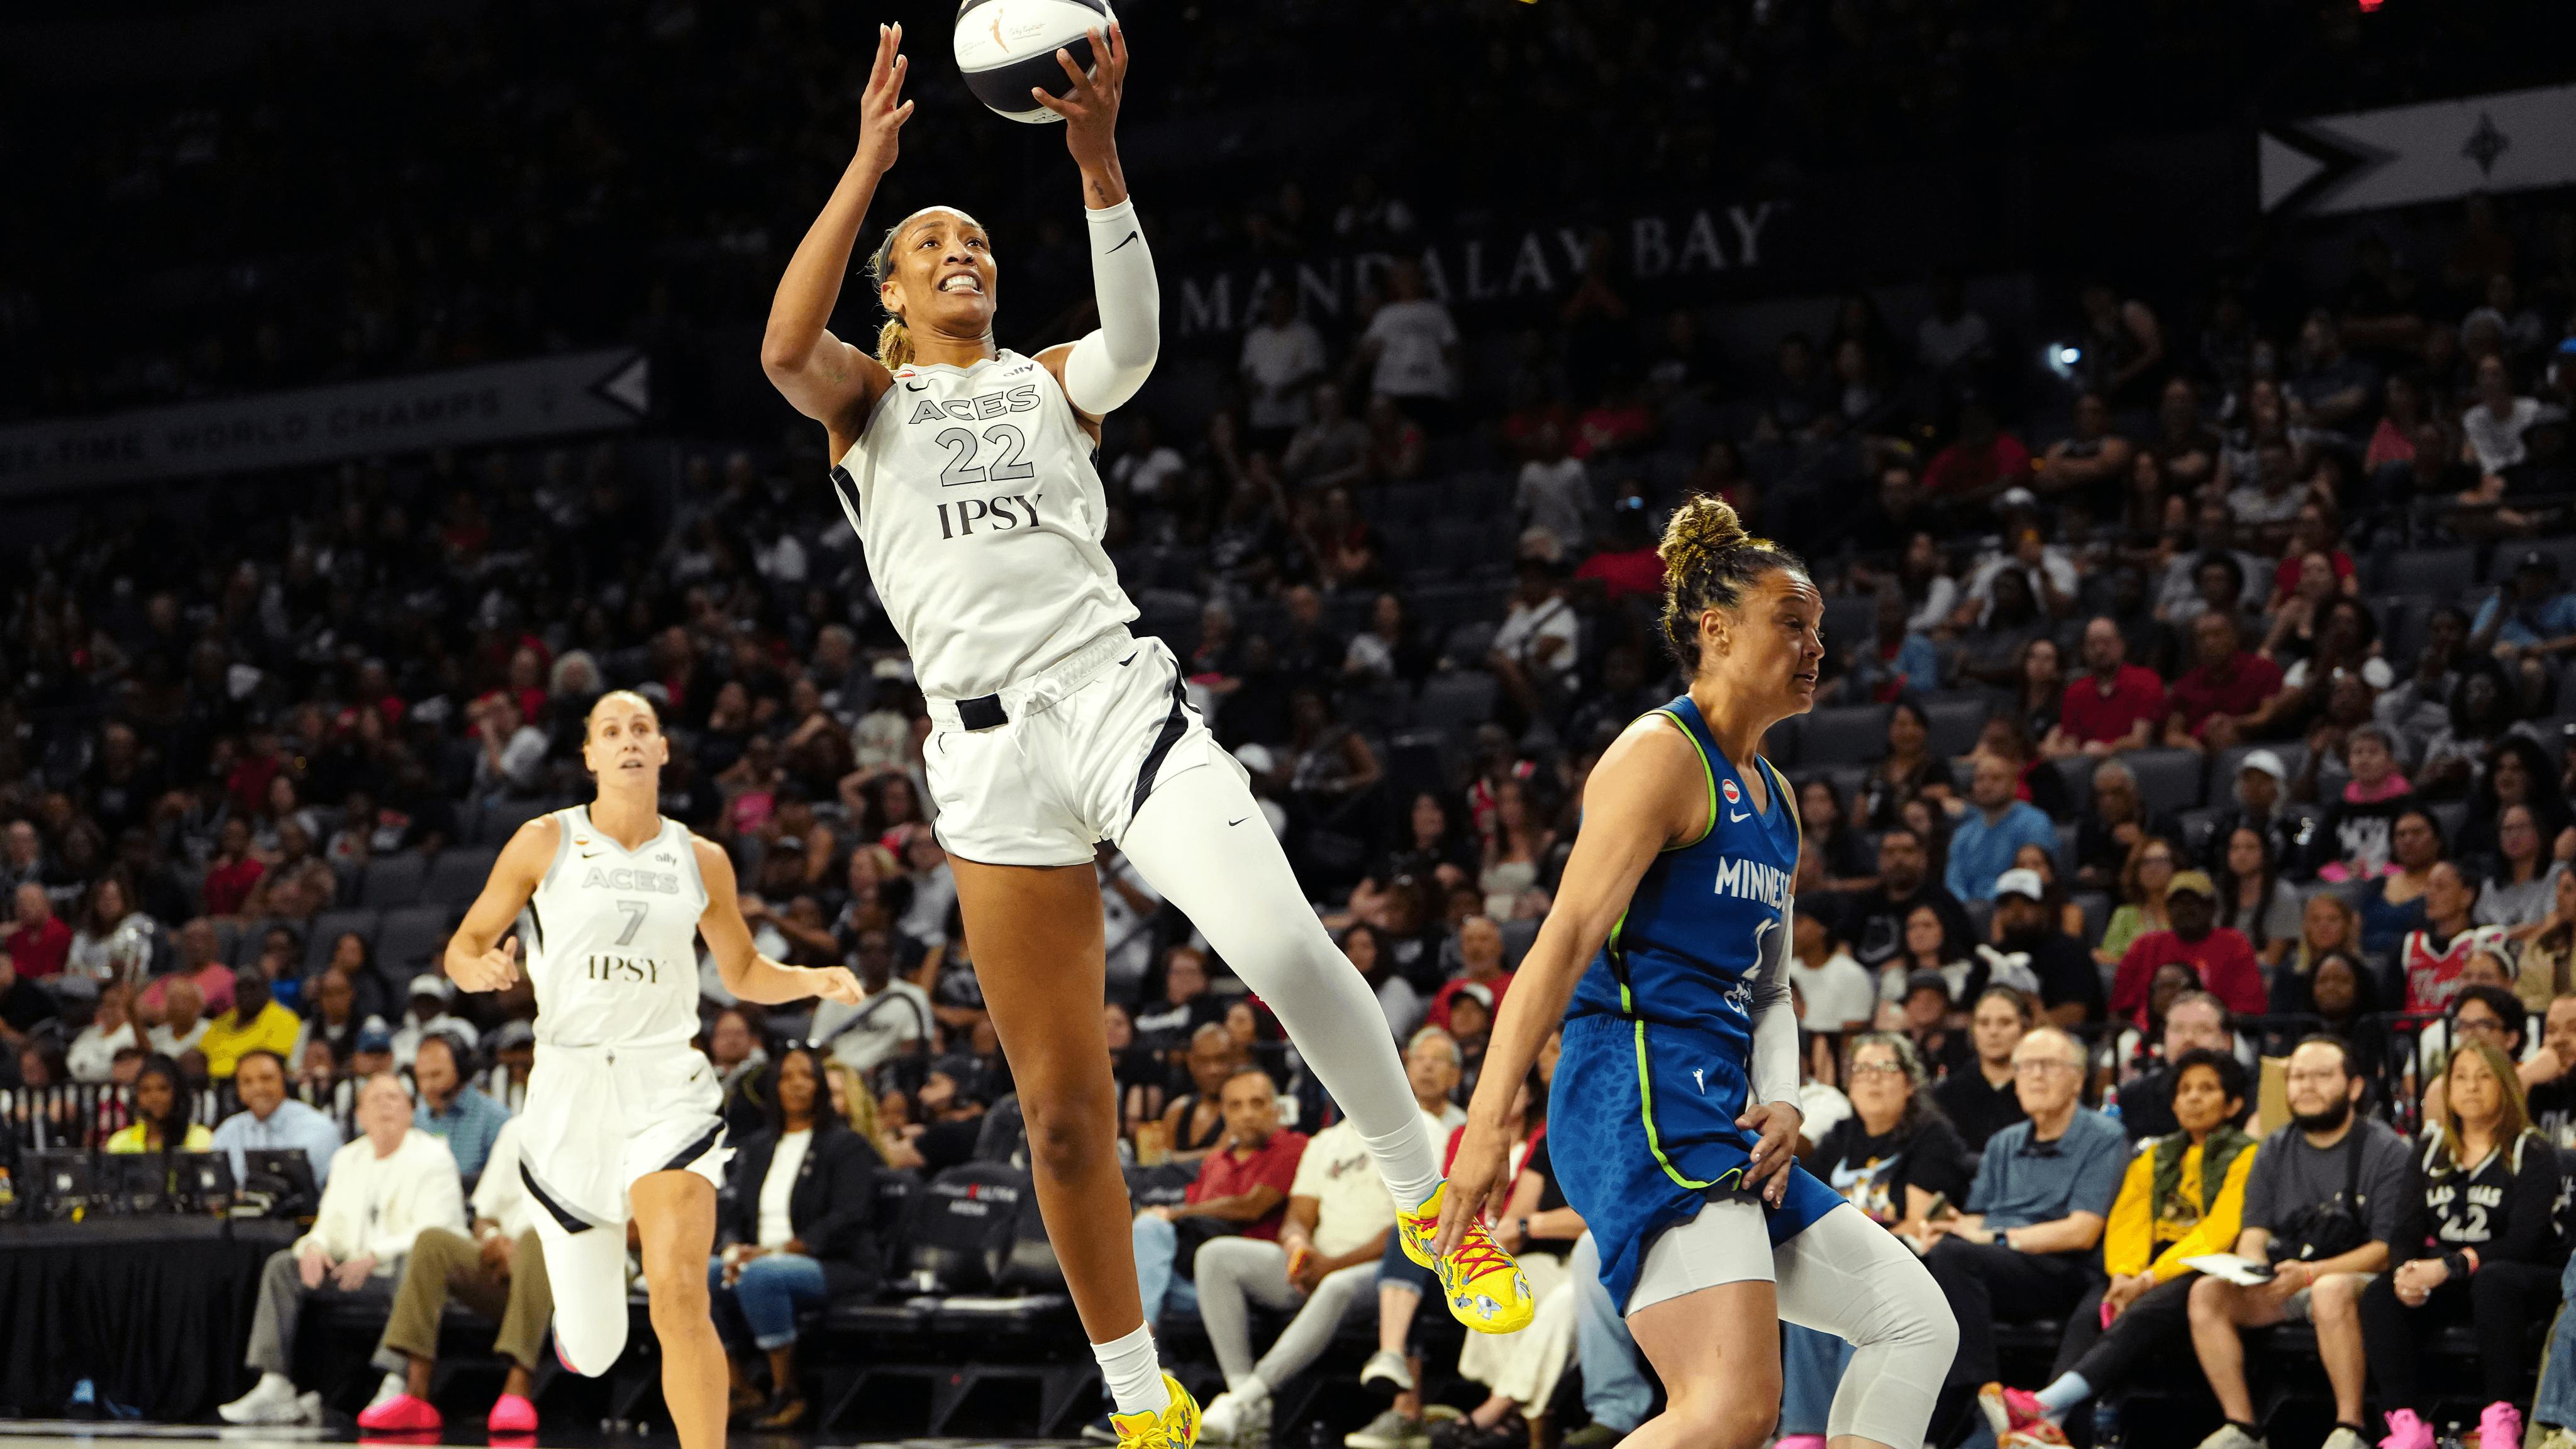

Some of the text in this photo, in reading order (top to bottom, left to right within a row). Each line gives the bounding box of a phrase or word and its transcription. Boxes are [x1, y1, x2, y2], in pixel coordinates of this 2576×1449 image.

[1633, 201, 1774, 279] BAY
[909, 384, 1040, 425] ACES
[167, 412, 309, 455] WORLD
[935, 424, 1035, 487] 22
[936, 494, 1043, 540] IPSY
[581, 867, 680, 895] ACES
[614, 899, 649, 946] 7
[589, 954, 667, 984] IPSY
[2436, 1202, 2492, 1242] 22
